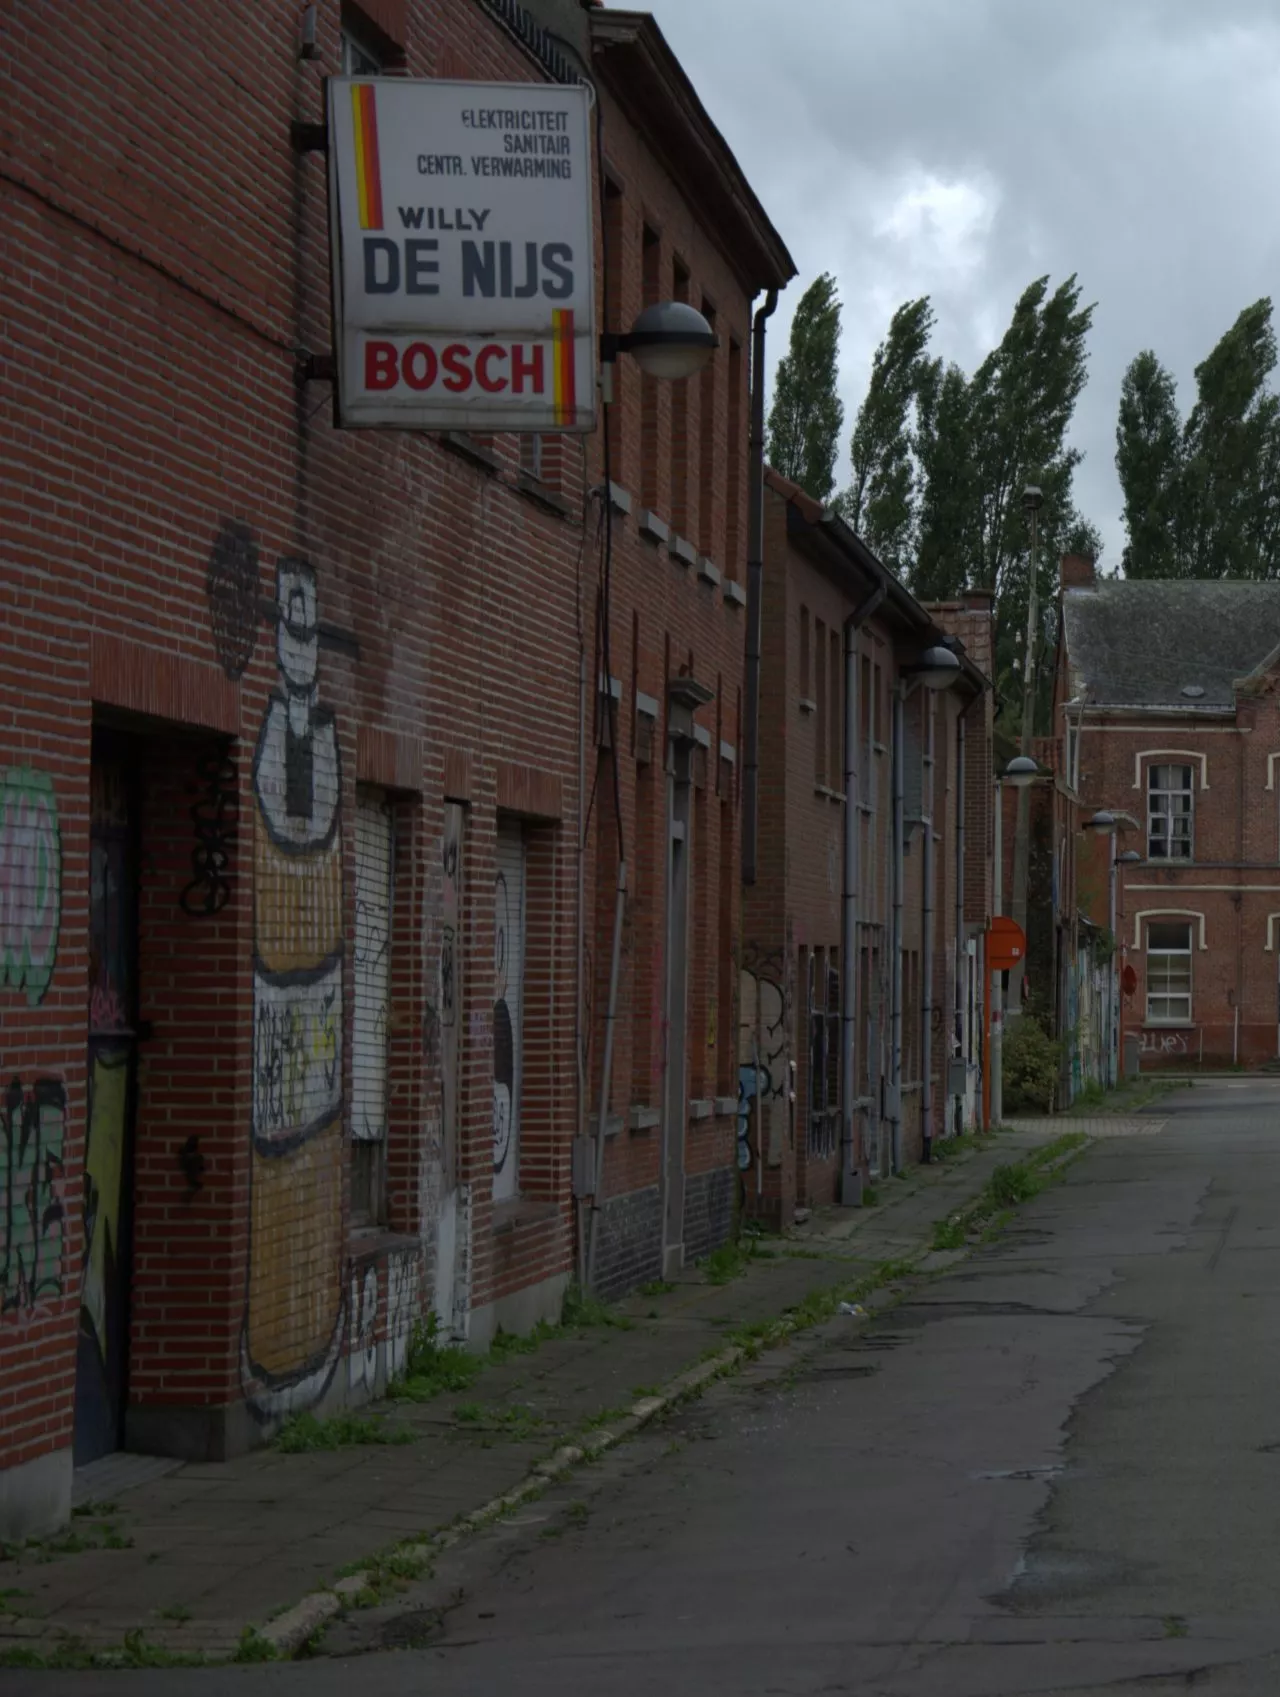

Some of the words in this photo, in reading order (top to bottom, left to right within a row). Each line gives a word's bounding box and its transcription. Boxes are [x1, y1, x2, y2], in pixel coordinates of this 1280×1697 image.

[461, 109, 569, 132] ELEKTRICITEIT
[503, 133, 571, 155] SANITAIR
[416, 154, 468, 176] CENTR.
[471, 156, 572, 180] VERWARMING
[397, 206, 491, 231] WILLY
[362, 237, 440, 296] DE
[461, 240, 575, 299] NIJS
[364, 340, 545, 394] BOSCH
